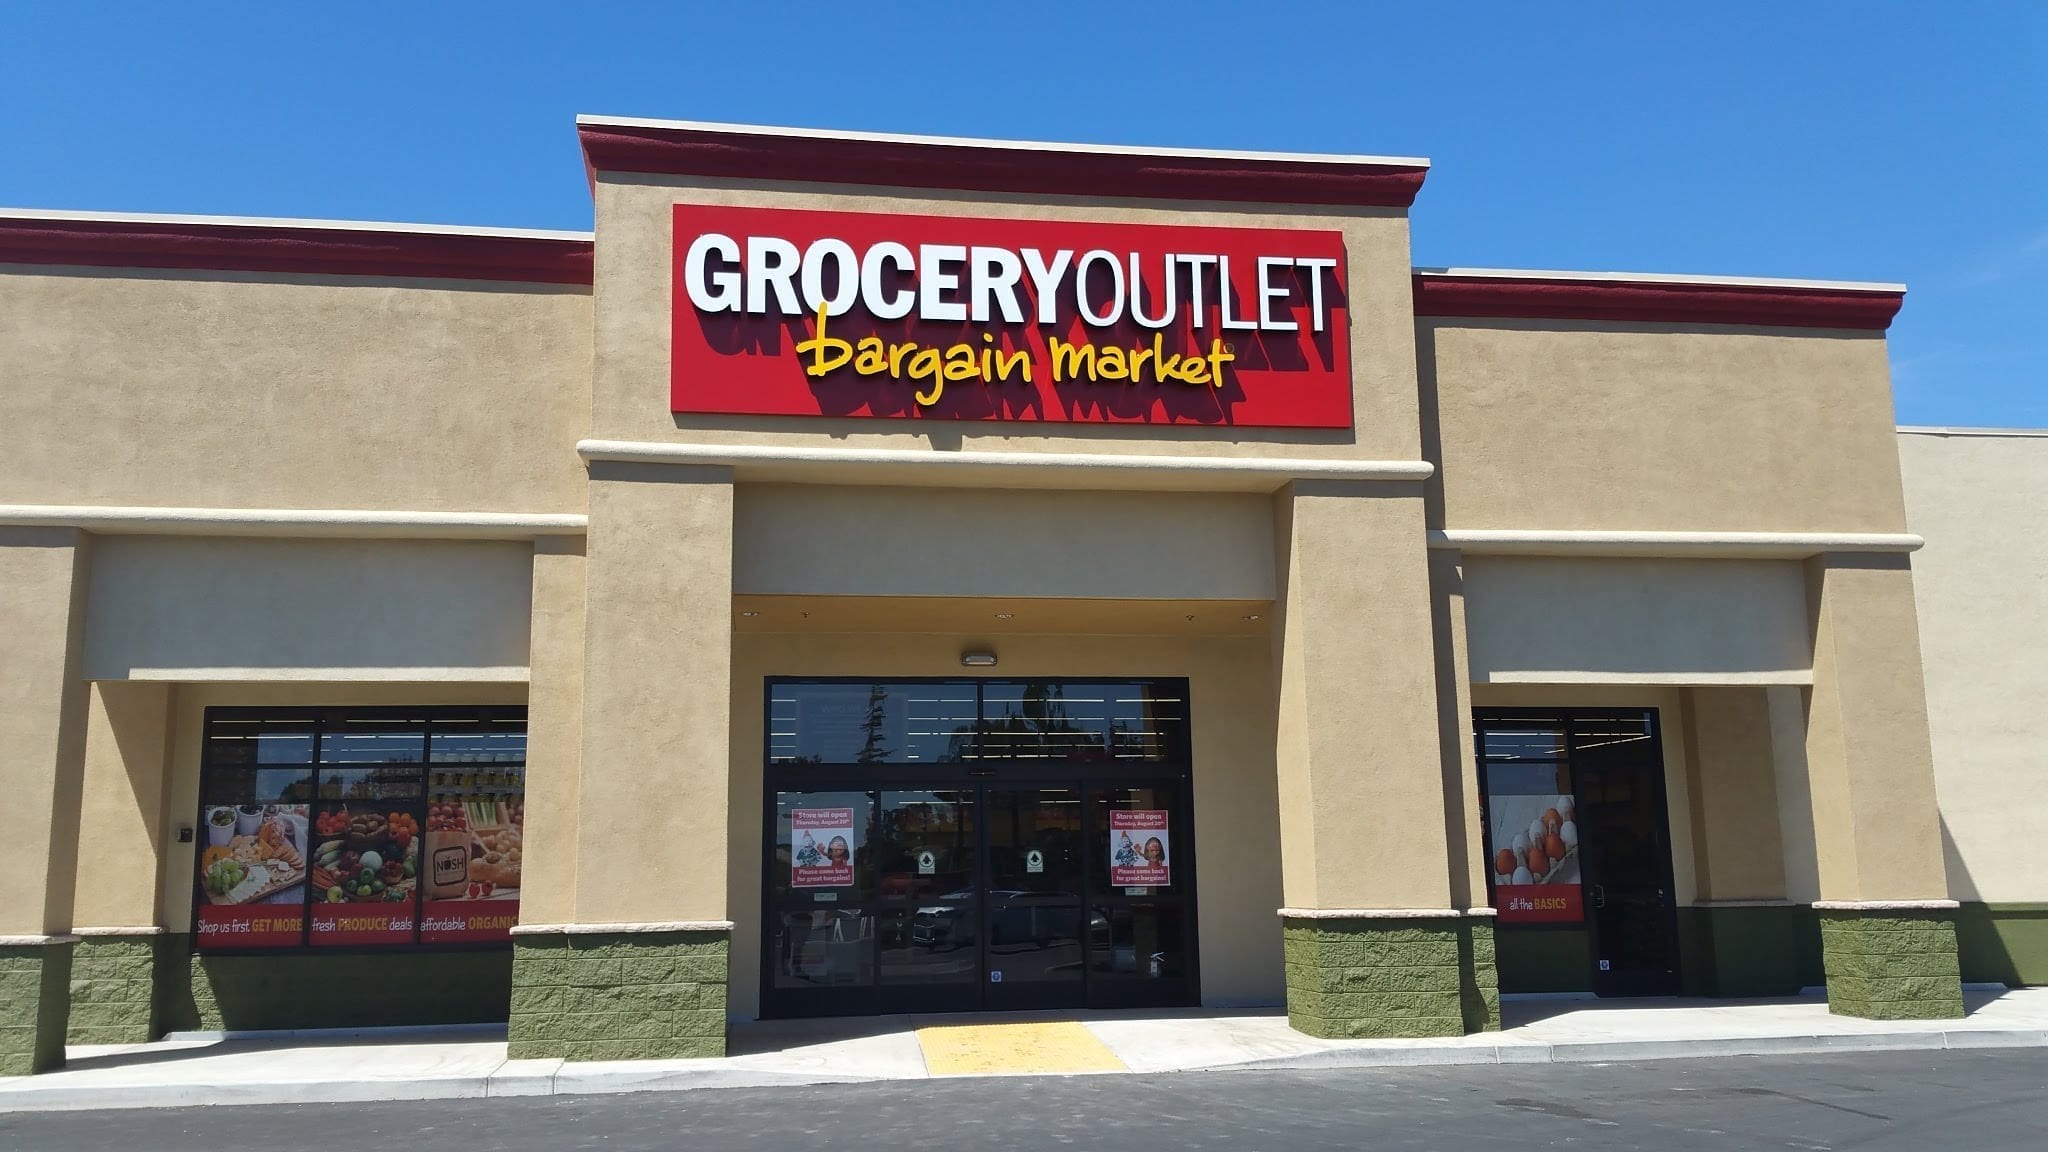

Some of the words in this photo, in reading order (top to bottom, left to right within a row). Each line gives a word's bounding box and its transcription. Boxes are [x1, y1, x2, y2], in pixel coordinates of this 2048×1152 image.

[796, 301, 1032, 405] bargain
[1049, 333, 1235, 387] market
[798, 811, 817, 819] Store
[831, 812, 848, 820] open
[799, 868, 818, 876] Please
[1509, 897, 1519, 911] all
[1519, 897, 1534, 911] the
[1534, 897, 1567, 910] BASICS
[197, 919, 219, 937] Shop
[219, 922, 230, 933] us
[251, 918, 272, 932] GET
[272, 918, 304, 932] MORE
[311, 917, 336, 932] fresh
[337, 917, 388, 932] PRODUCE
[388, 916, 413, 931] deals
[419, 916, 466, 932] affordable
